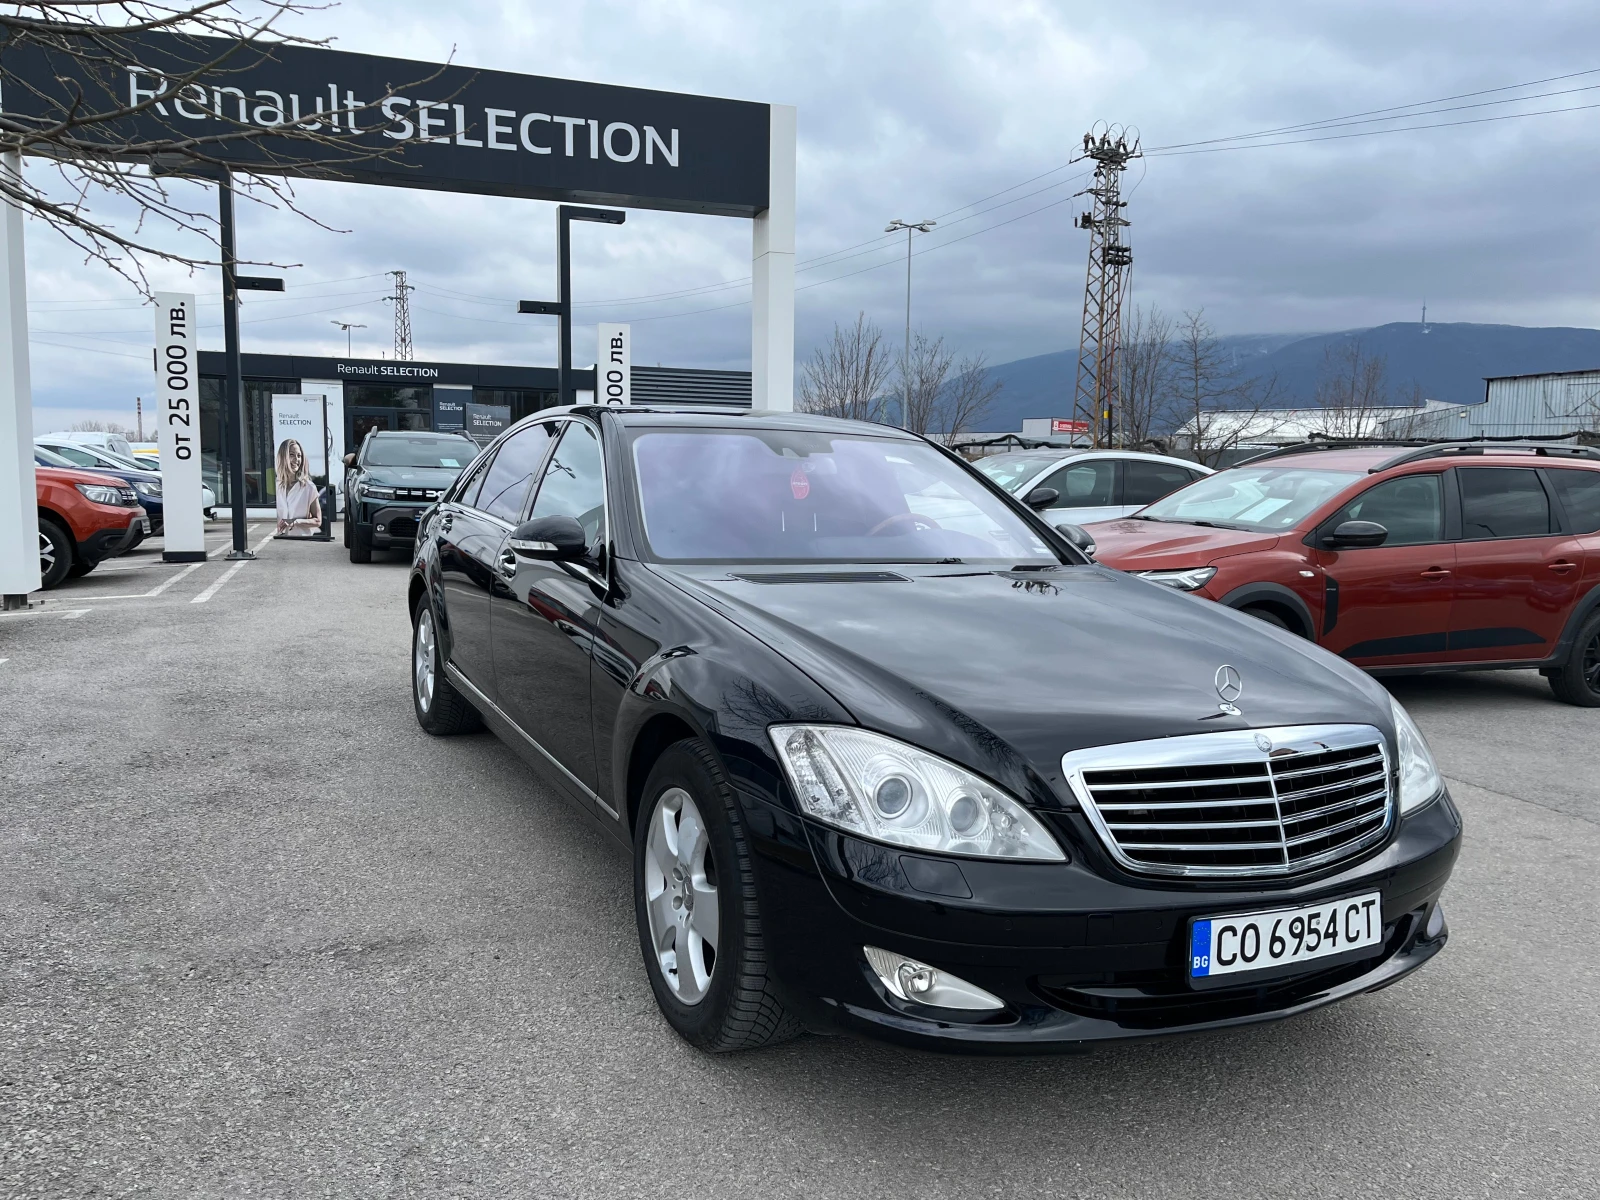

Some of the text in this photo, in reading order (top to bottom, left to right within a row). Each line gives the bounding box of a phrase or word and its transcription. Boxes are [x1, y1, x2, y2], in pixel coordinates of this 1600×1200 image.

[127, 66, 679, 168] Renault SELECTION
[610, 331, 624, 365] лв.
[166, 301, 192, 460] от 25 000 лв.
[337, 363, 439, 378] Renault SELECTION
[472, 419, 502, 427] SELECTION
[1216, 898, 1376, 967] CO 6954 CT
[1193, 955, 1209, 969] BG
